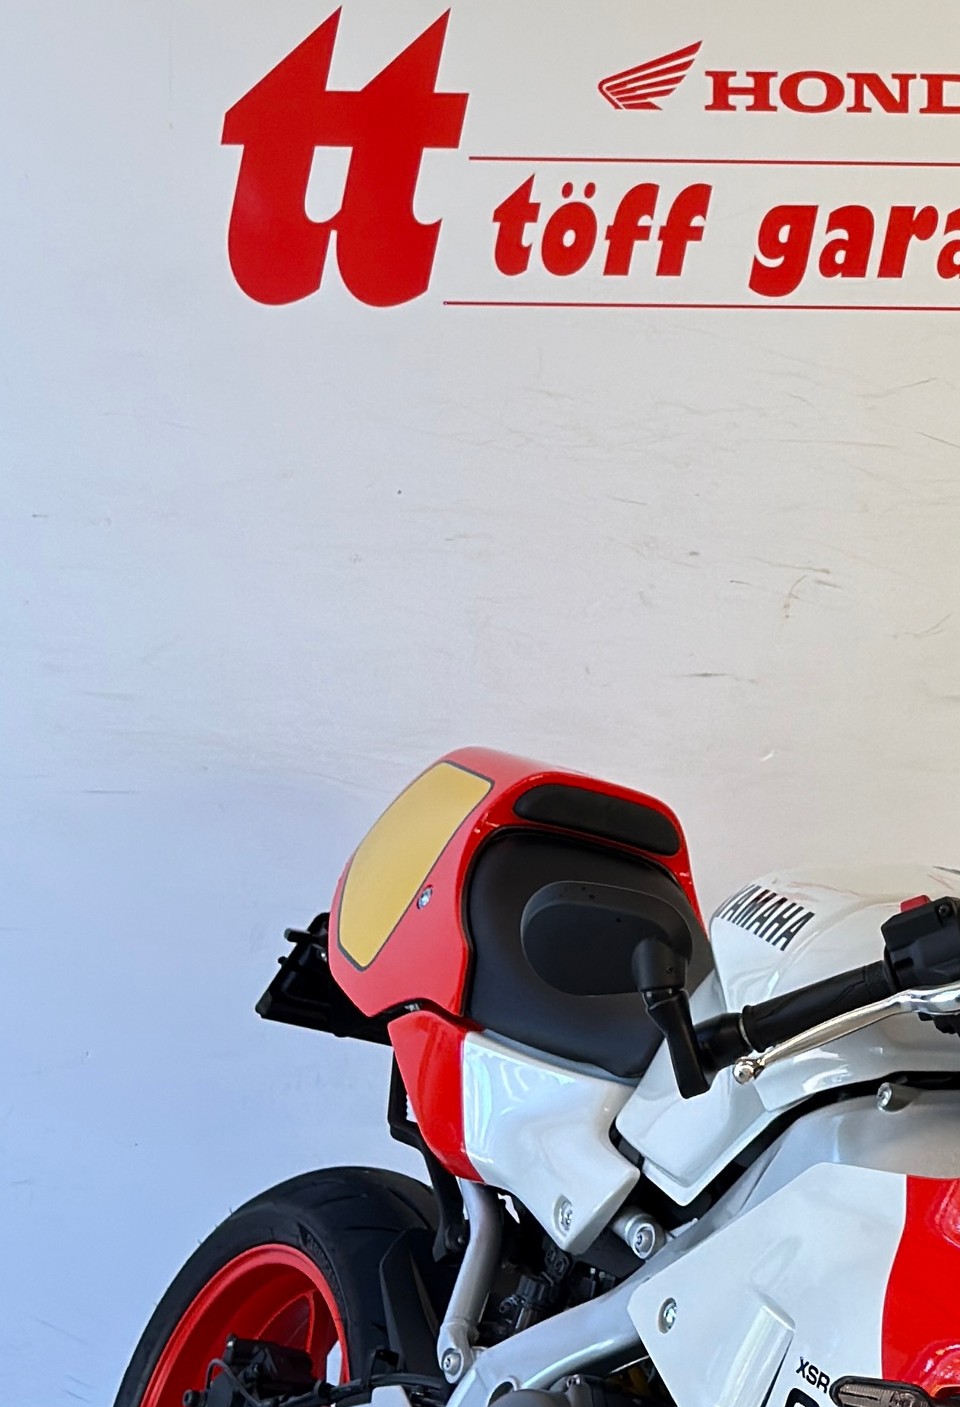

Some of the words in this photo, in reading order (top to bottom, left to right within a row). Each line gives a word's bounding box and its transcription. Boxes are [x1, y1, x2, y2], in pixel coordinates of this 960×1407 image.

[492, 173, 712, 277] töff
[711, 884, 816, 952] YAMAHA
[796, 1357, 831, 1394] XSR
